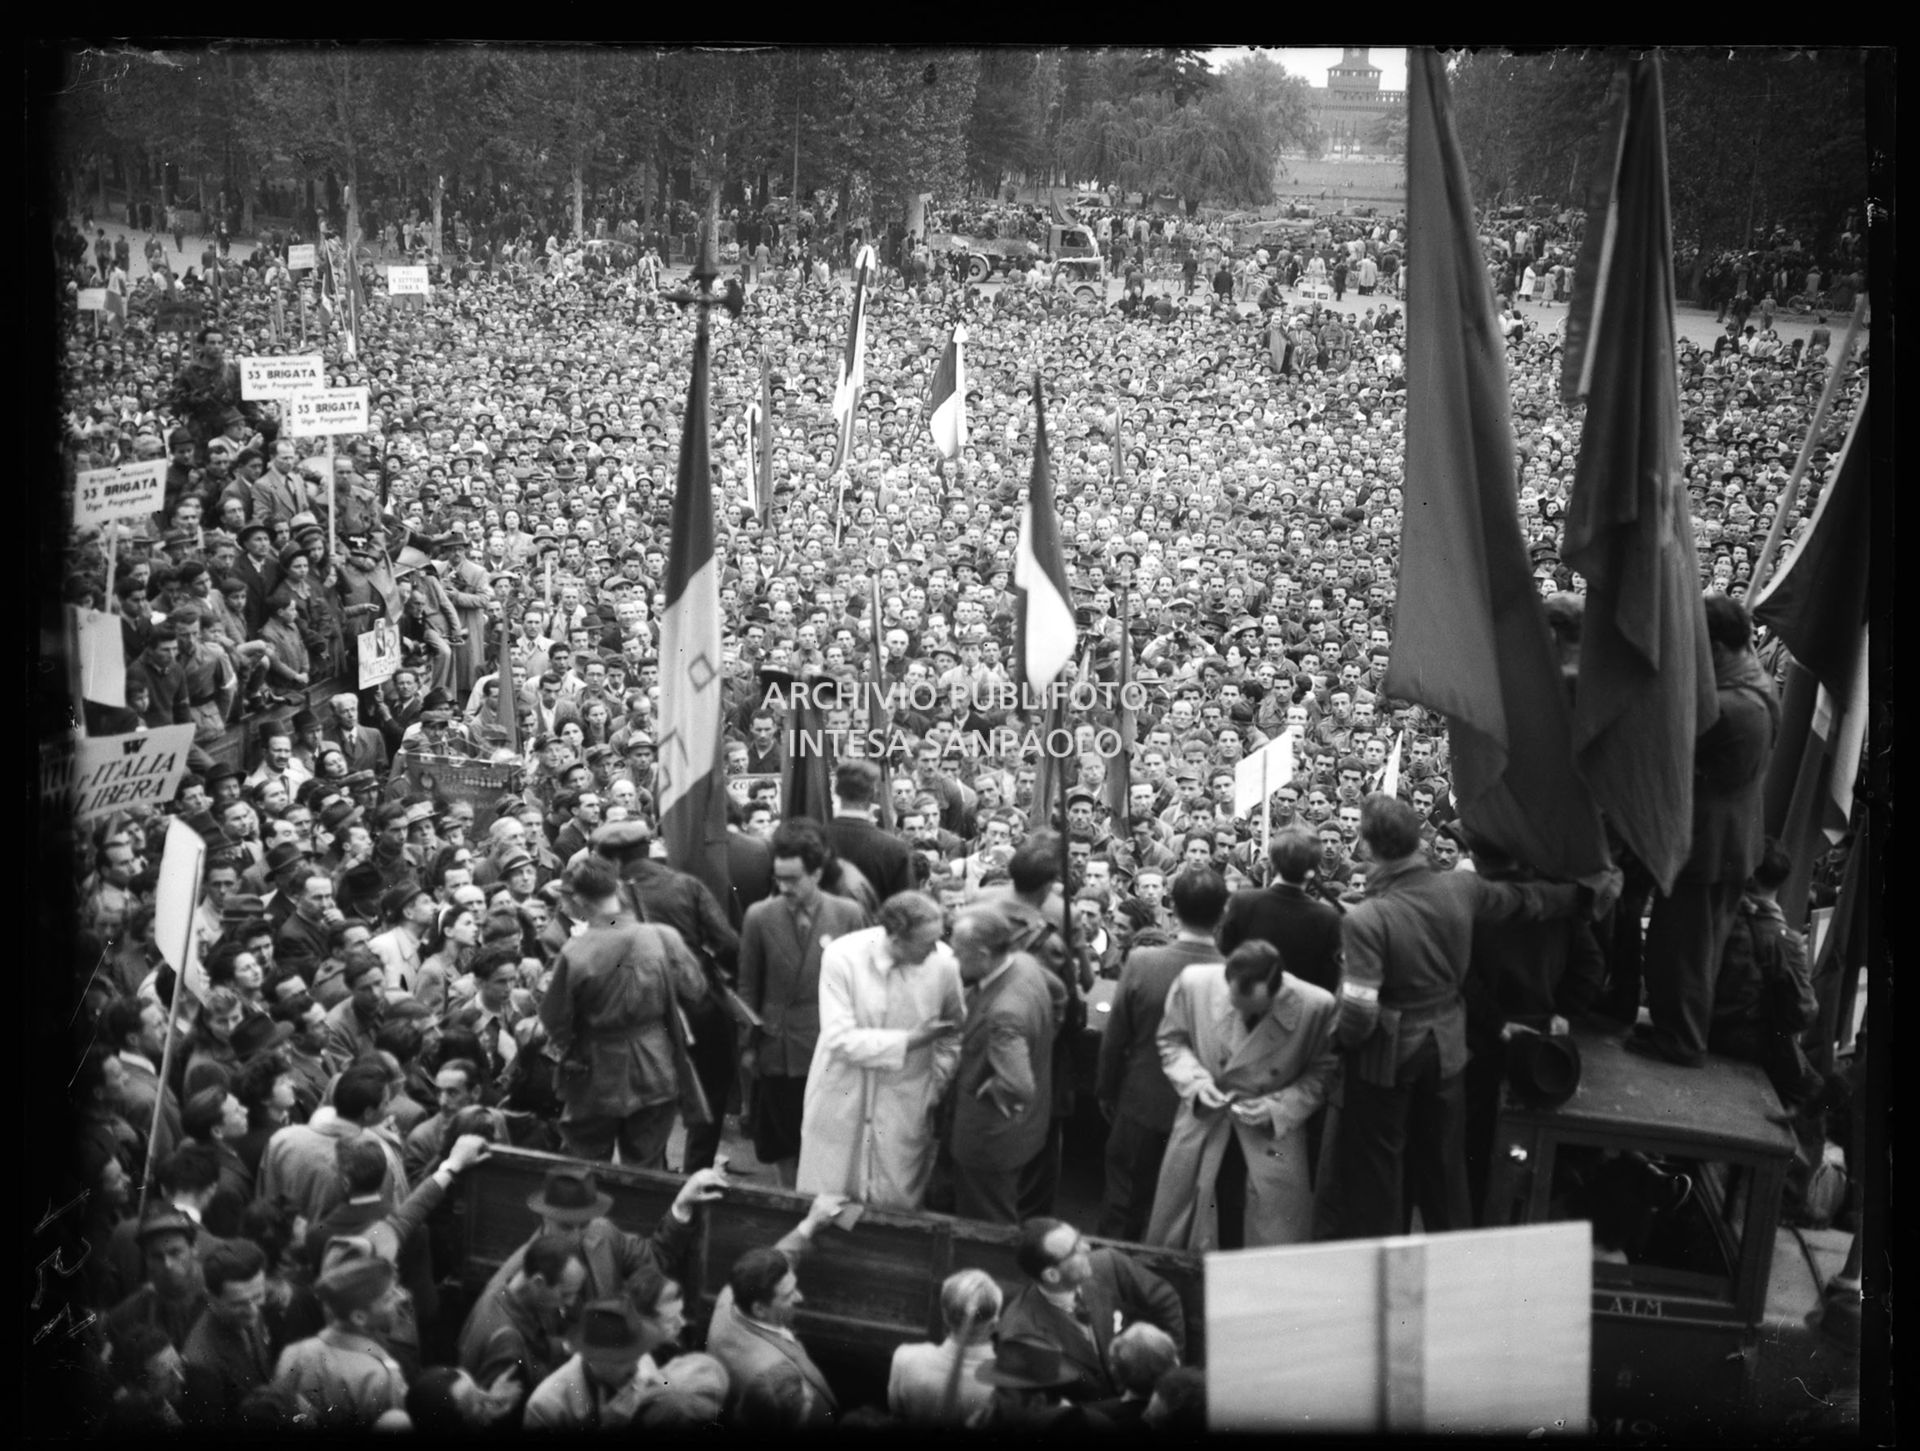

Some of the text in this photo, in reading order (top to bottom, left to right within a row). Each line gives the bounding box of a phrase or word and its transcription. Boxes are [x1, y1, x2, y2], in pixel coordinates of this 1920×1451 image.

[267, 369, 317, 379] BRIGATA
[315, 401, 361, 413] BRIGATA
[104, 477, 158, 497] BRIGATA
[123, 737, 148, 756] W
[74, 777, 165, 816] LIBERA
